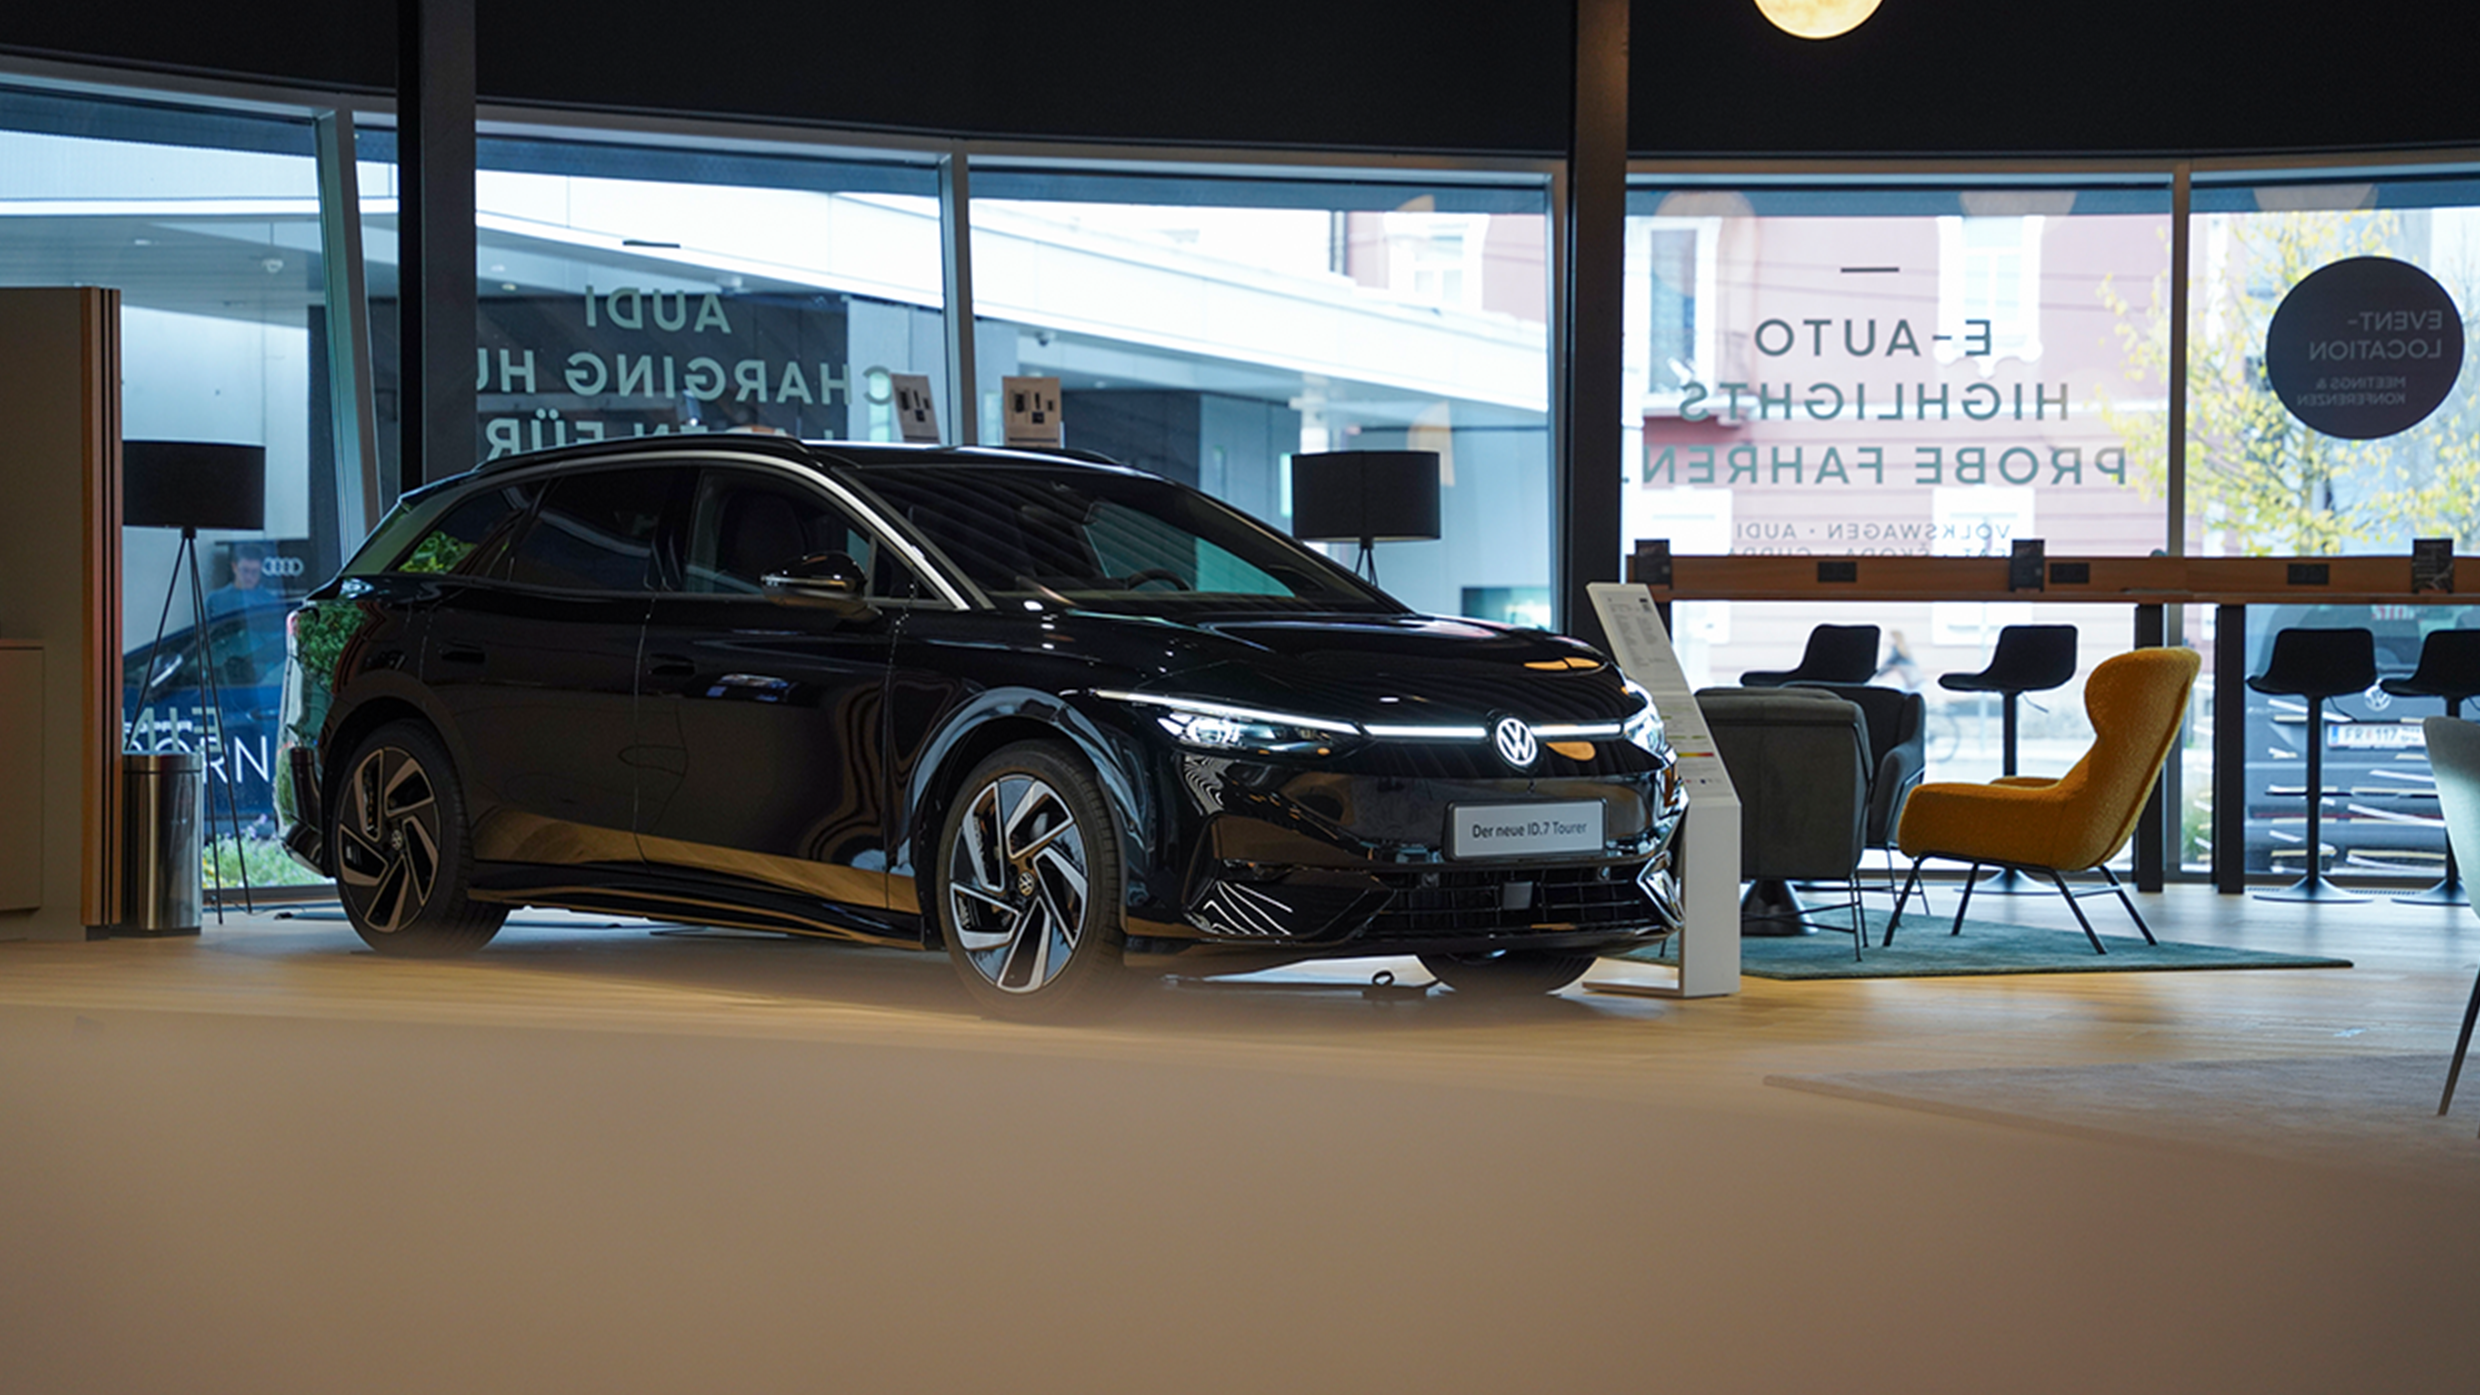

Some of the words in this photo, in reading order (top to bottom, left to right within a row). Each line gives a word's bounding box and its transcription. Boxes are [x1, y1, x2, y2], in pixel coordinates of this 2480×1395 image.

[1472, 824, 1493, 838] Der
[1496, 825, 1525, 837] neue
[1527, 822, 1550, 836] ID.7
[1552, 821, 1588, 835] Tourer
